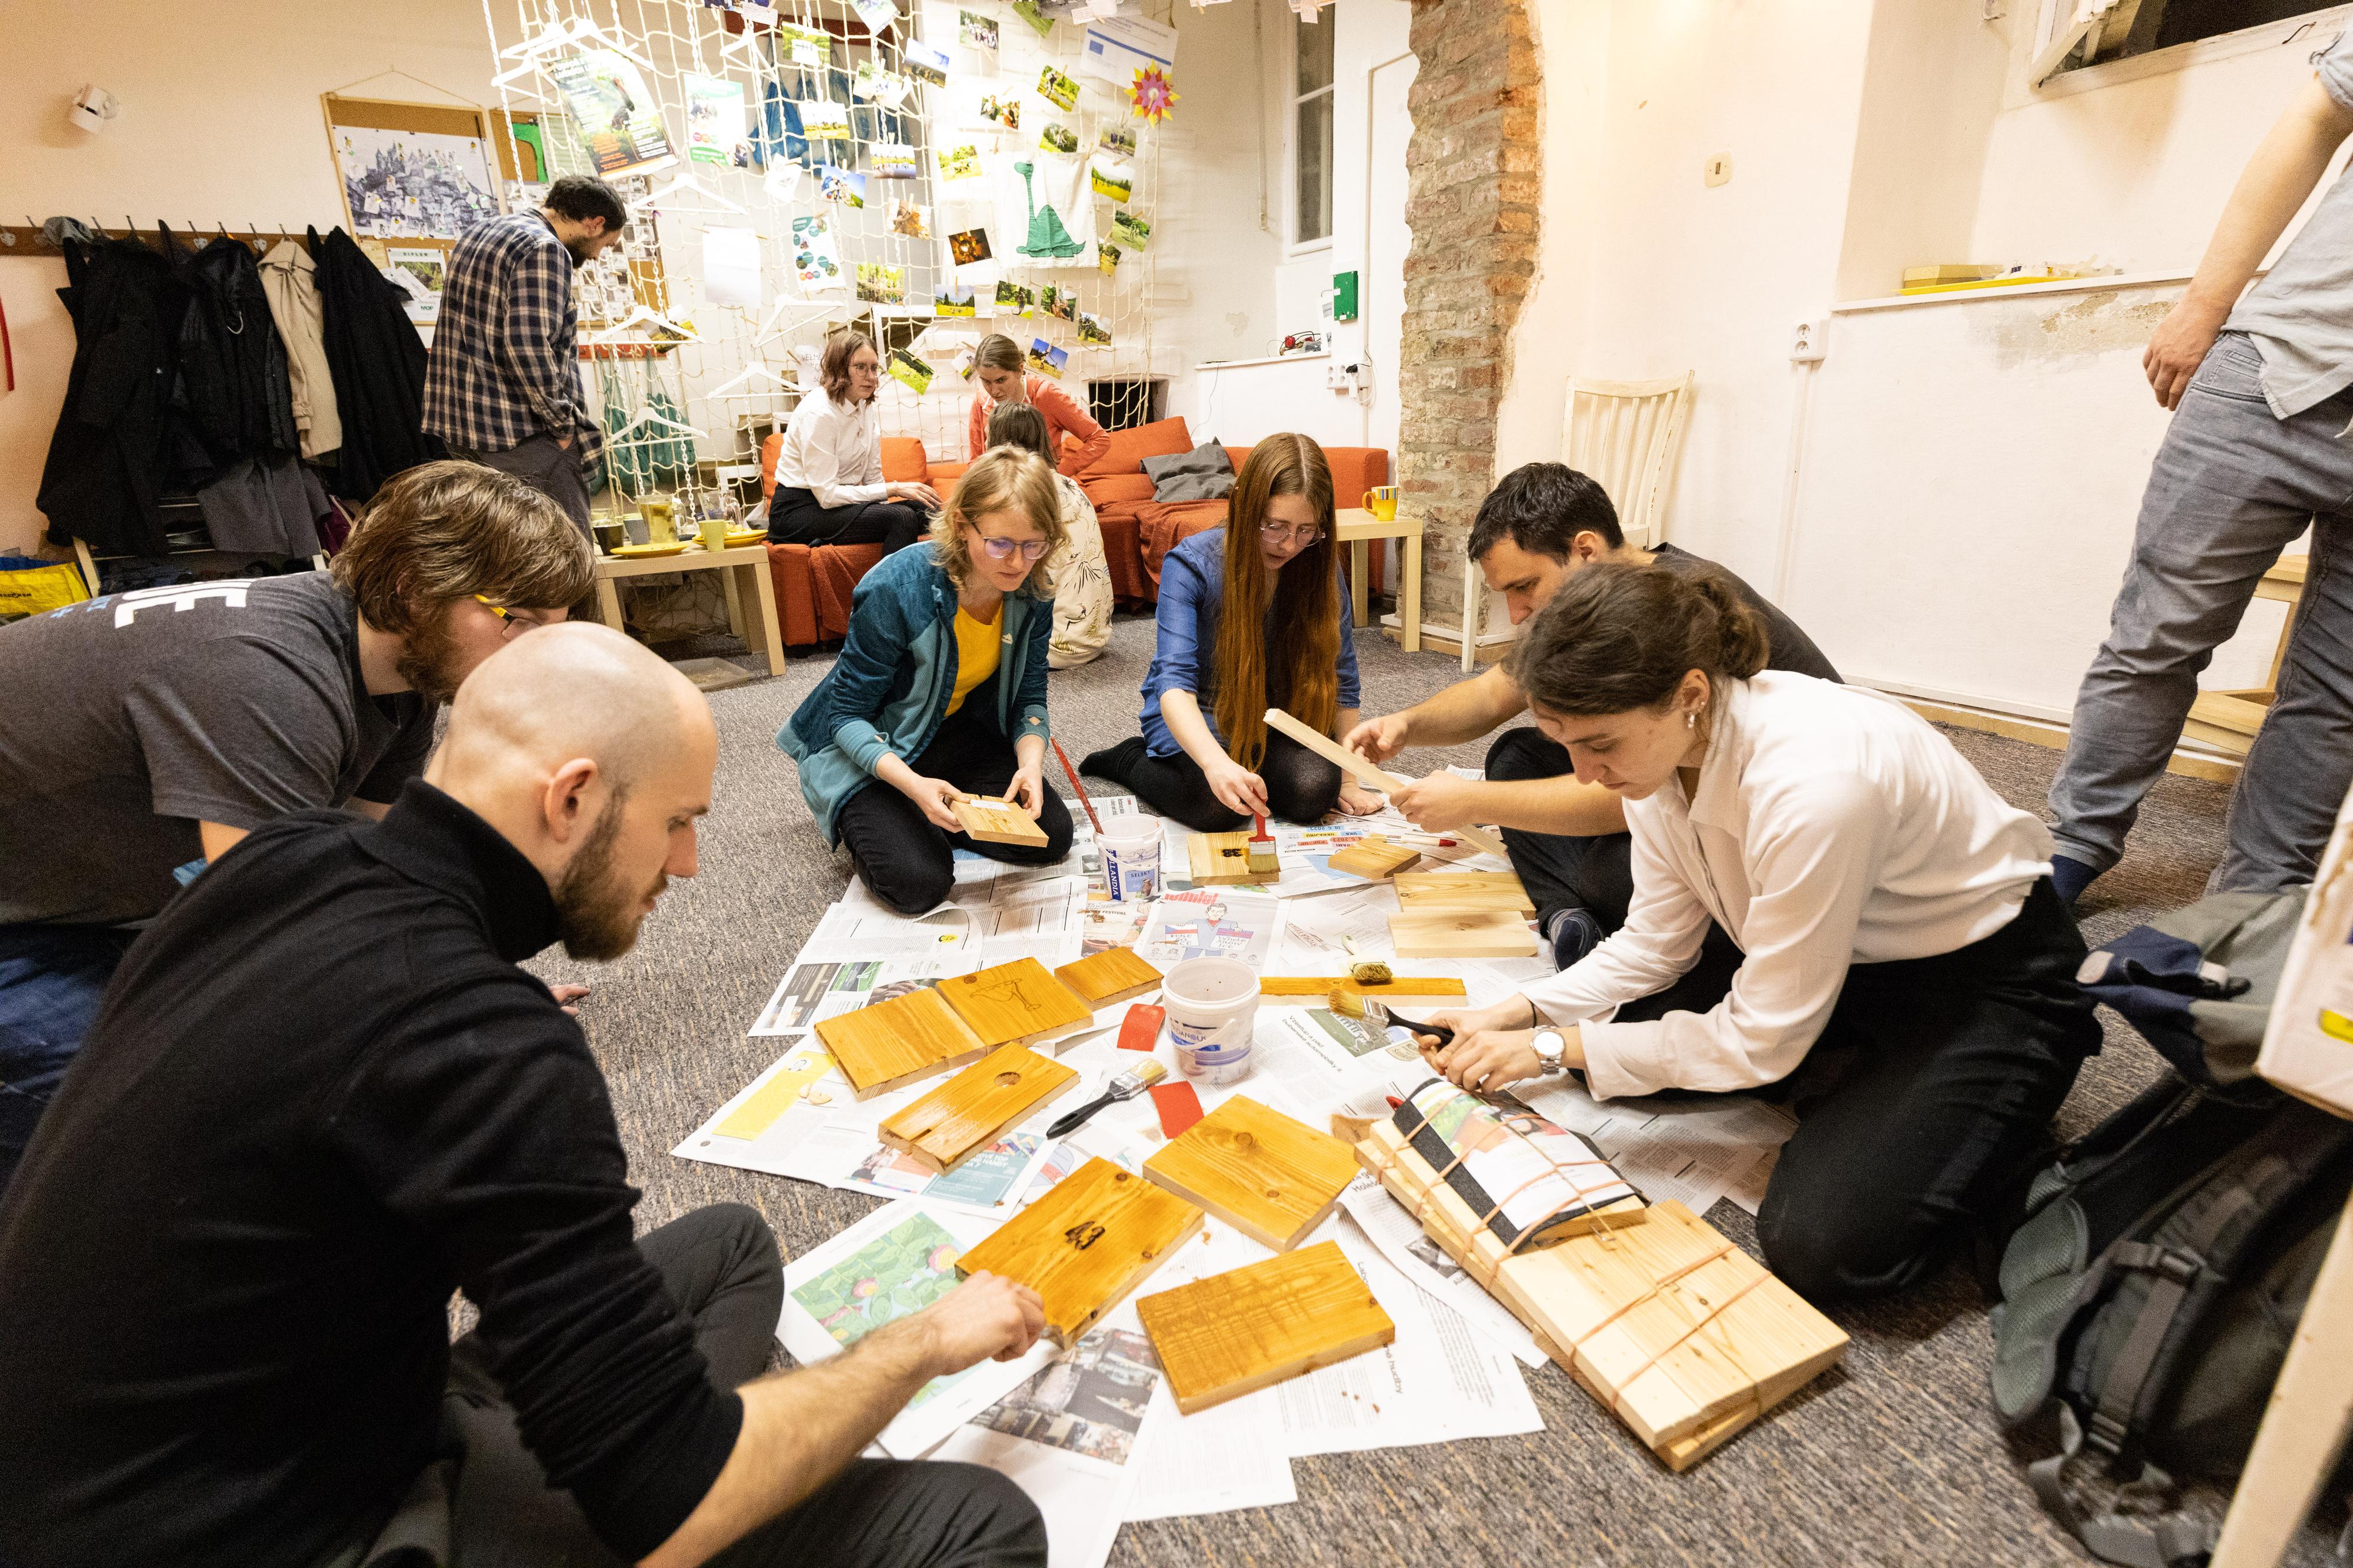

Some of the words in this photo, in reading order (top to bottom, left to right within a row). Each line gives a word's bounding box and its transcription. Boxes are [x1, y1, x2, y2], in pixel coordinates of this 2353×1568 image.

[1108, 849, 1119, 895] HLLANDIA
[1289, 1015, 1309, 1036] Vzestup
[1306, 1040, 1338, 1068] automobilky
[1065, 1221, 1105, 1250] 43
[1388, 1360, 1403, 1394] hudby
